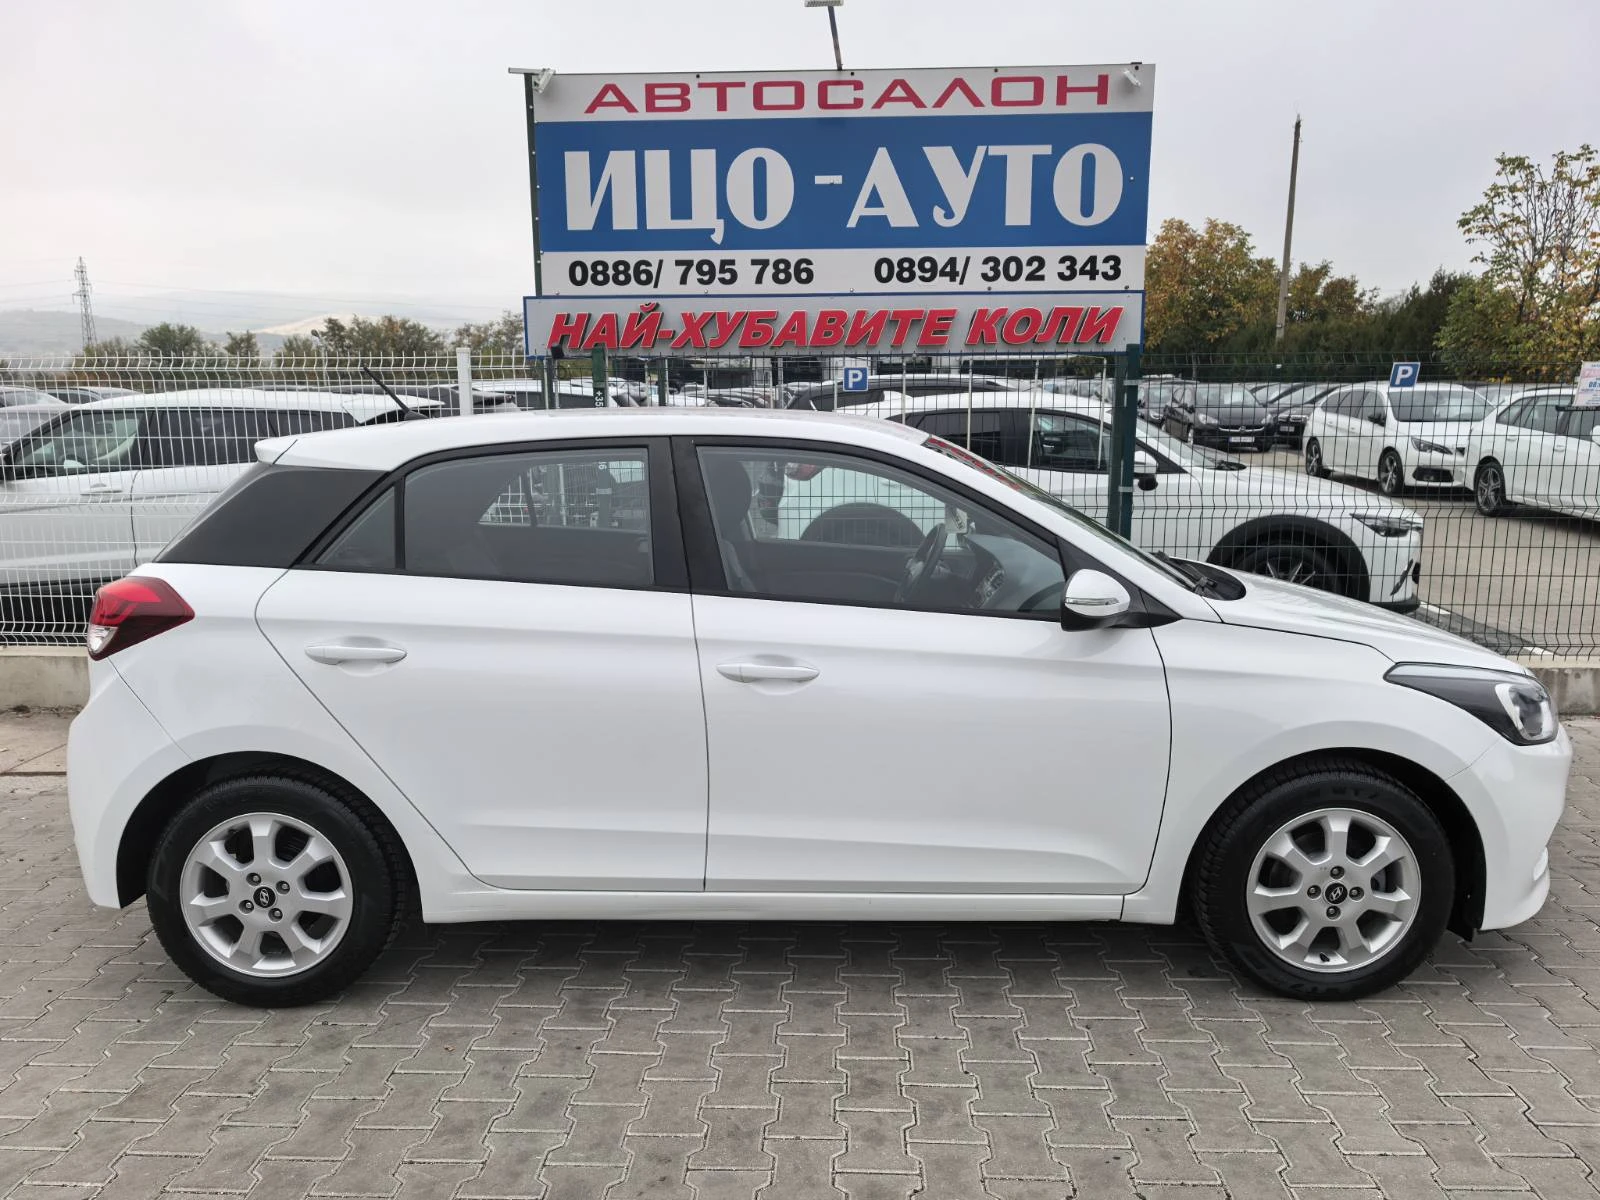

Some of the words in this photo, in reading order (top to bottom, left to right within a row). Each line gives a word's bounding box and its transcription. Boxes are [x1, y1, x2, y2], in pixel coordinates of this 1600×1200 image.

[585, 74, 1109, 114] АВТОСАЛОН
[563, 147, 795, 246] ИЦО
[568, 259, 664, 289] 0886/
[674, 259, 738, 287] 795
[750, 258, 815, 286] 786
[874, 256, 971, 286] 0894/
[980, 255, 1046, 283] 302
[1057, 254, 1122, 283] 343
[547, 302, 957, 350] НАЙ-ХУБАВИТЕ
[967, 307, 1124, 347] КОЛИ
[848, 369, 863, 389] P
[1394, 365, 1413, 385] P
